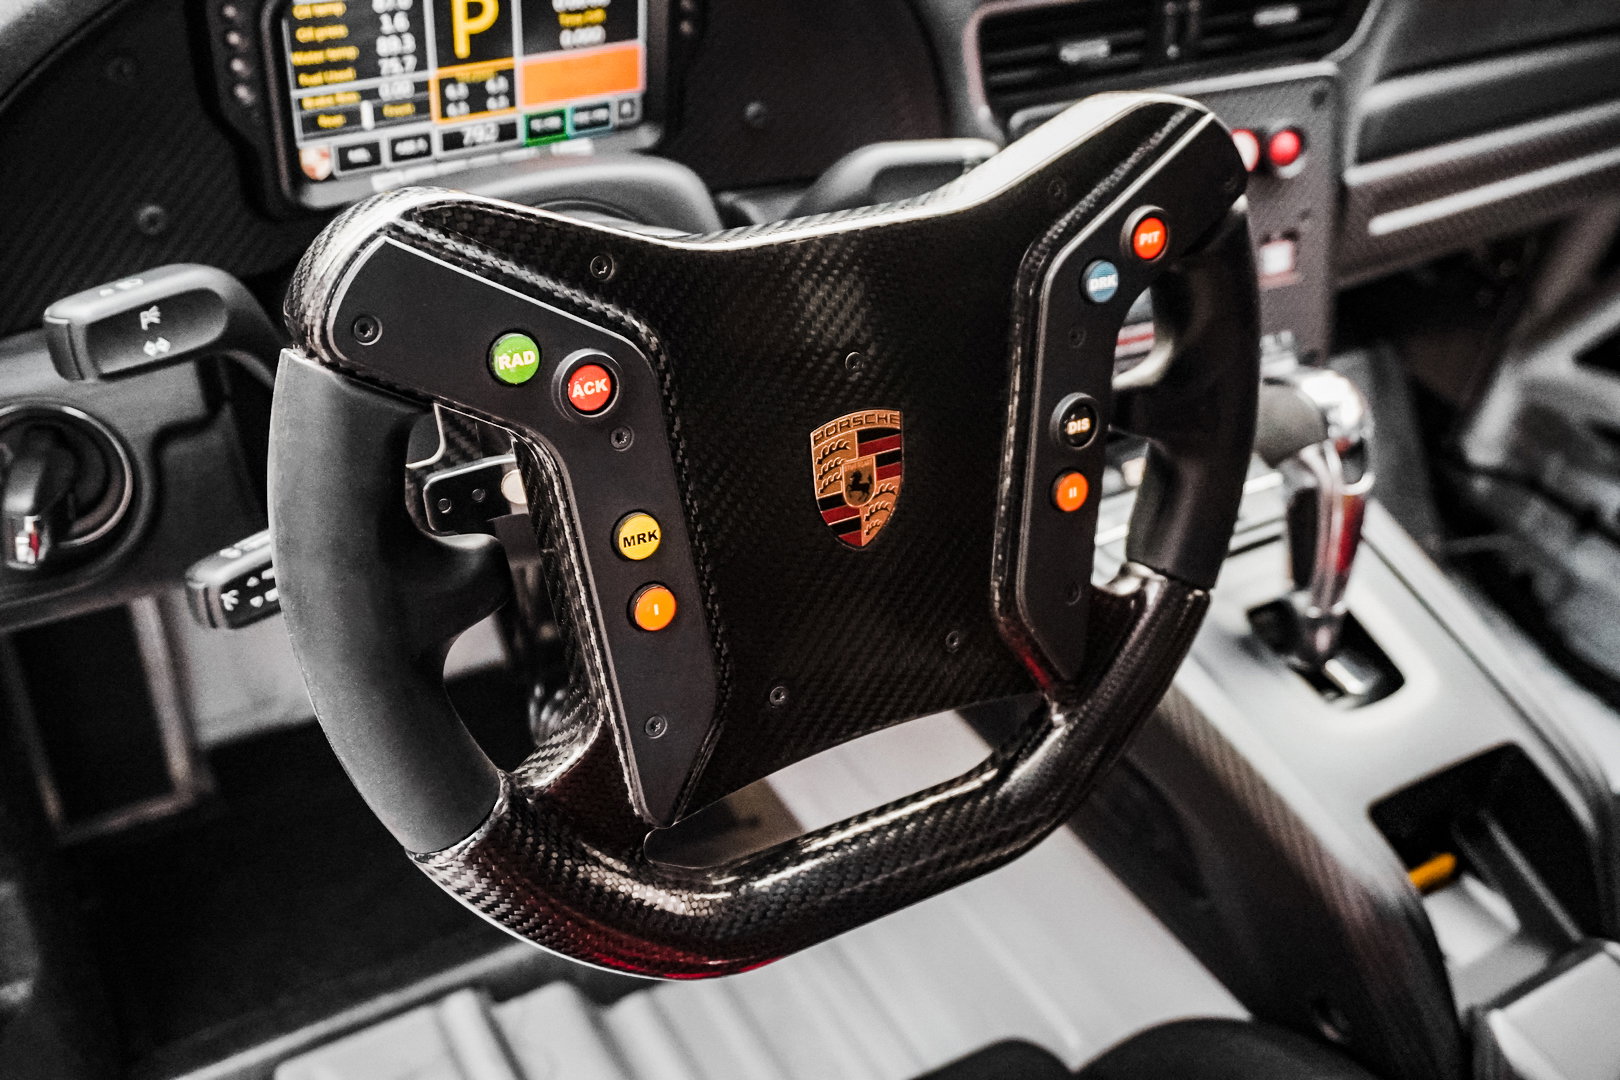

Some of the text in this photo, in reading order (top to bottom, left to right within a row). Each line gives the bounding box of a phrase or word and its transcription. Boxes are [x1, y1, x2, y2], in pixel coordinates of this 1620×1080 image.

[451, 0, 499, 59] P
[1139, 230, 1160, 247] PIT
[498, 350, 536, 370] RAD
[571, 378, 608, 398] ACK
[813, 413, 900, 443] PORSCHE
[1067, 417, 1091, 435] DIS
[622, 529, 659, 548] MRK
